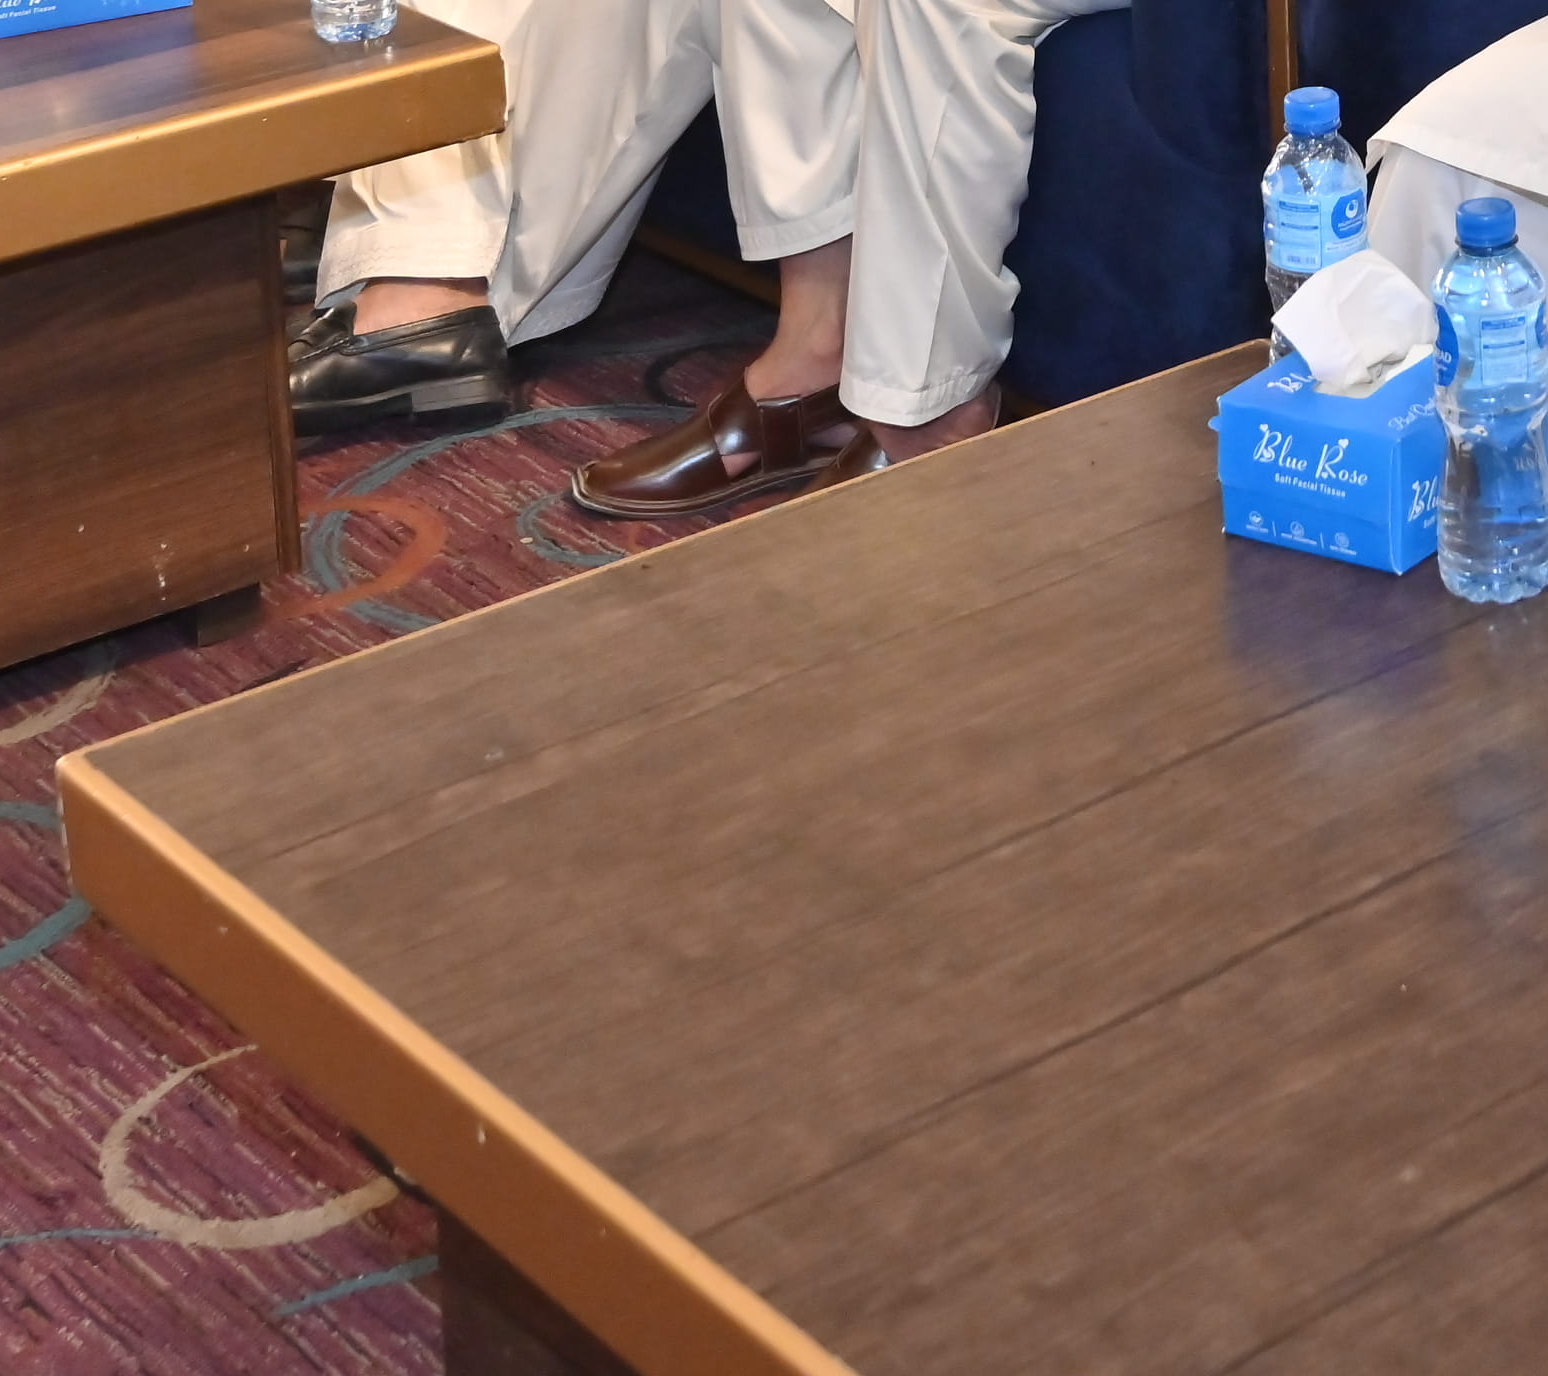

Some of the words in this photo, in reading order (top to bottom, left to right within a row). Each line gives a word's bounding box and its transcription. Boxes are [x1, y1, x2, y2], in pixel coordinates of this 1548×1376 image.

[9, 9, 32, 19] Facial
[33, 5, 57, 15] Tissue
[1253, 423, 1308, 471] Blue
[1315, 438, 1369, 486] Rose
[1274, 472, 1293, 485] Soft
[1292, 475, 1318, 492] Facial
[1319, 482, 1346, 498] Tissue
[1408, 475, 1438, 522] Blu
